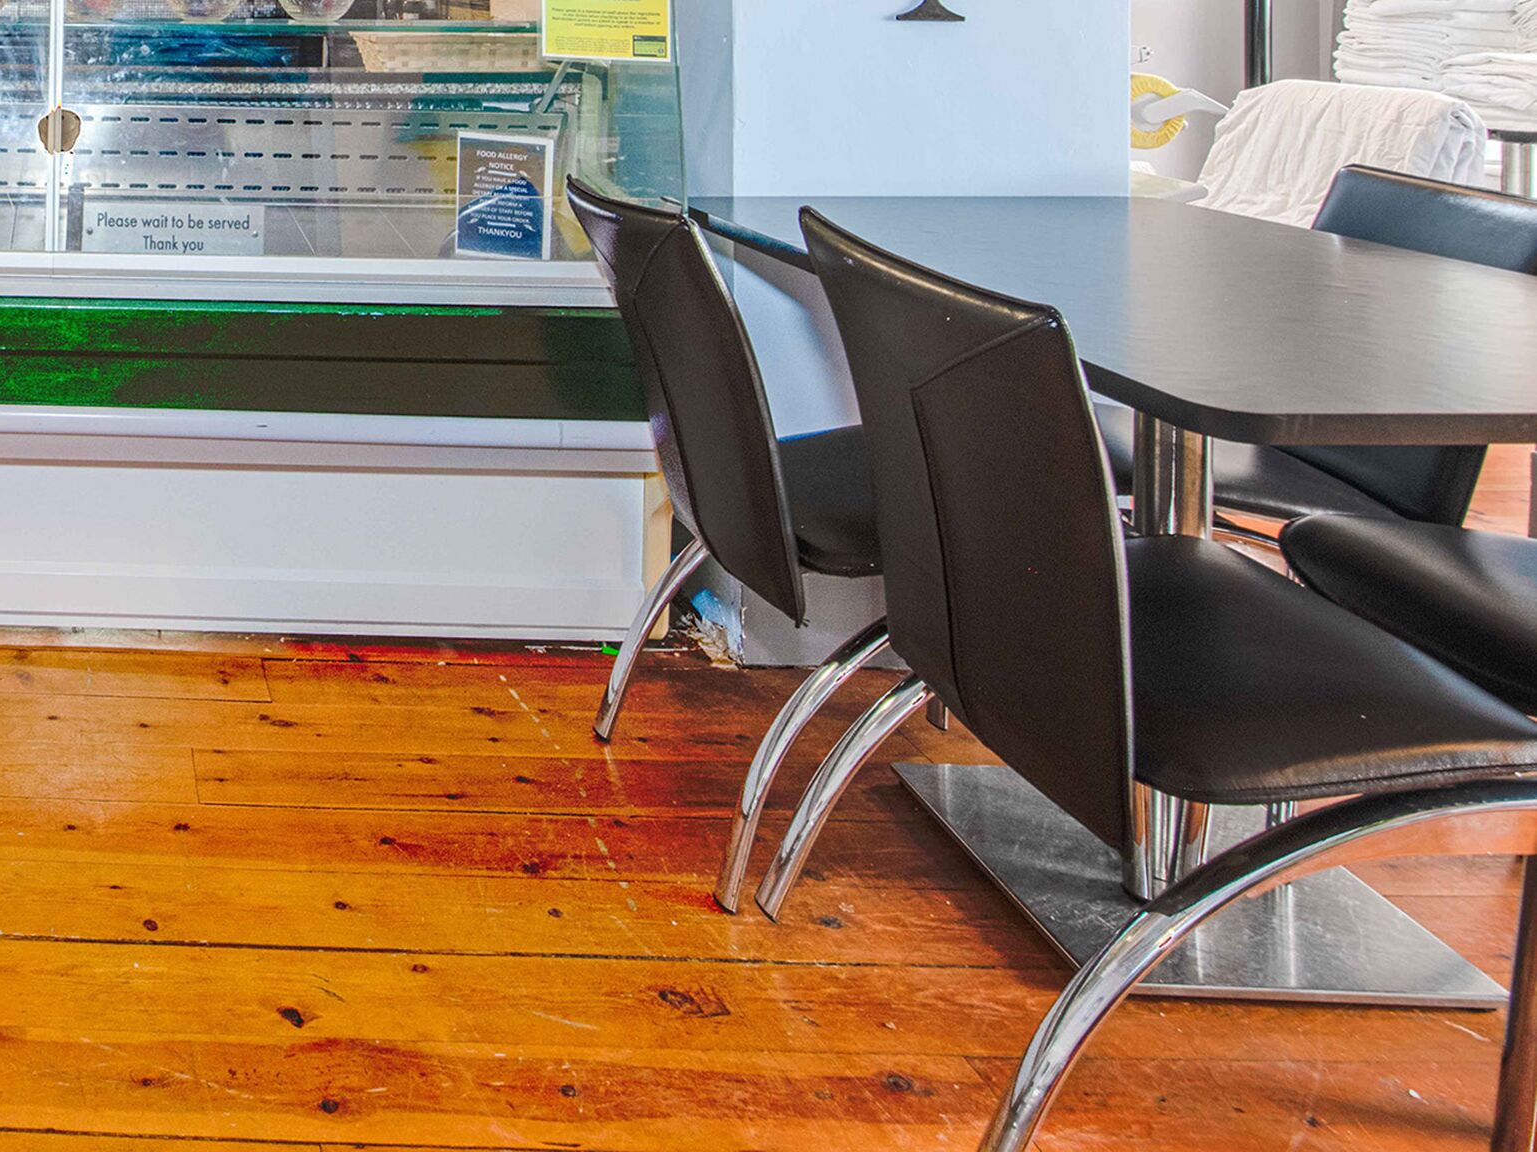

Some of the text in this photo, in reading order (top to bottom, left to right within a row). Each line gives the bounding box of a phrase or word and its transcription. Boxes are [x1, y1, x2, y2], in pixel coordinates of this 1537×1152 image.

[476, 150, 528, 161] FOOD ALLERGY
[489, 162, 514, 171] NOTICE
[97, 212, 250, 230] Please wait to be served
[478, 226, 522, 239] THANKYOU
[143, 235, 204, 254] Thank you
